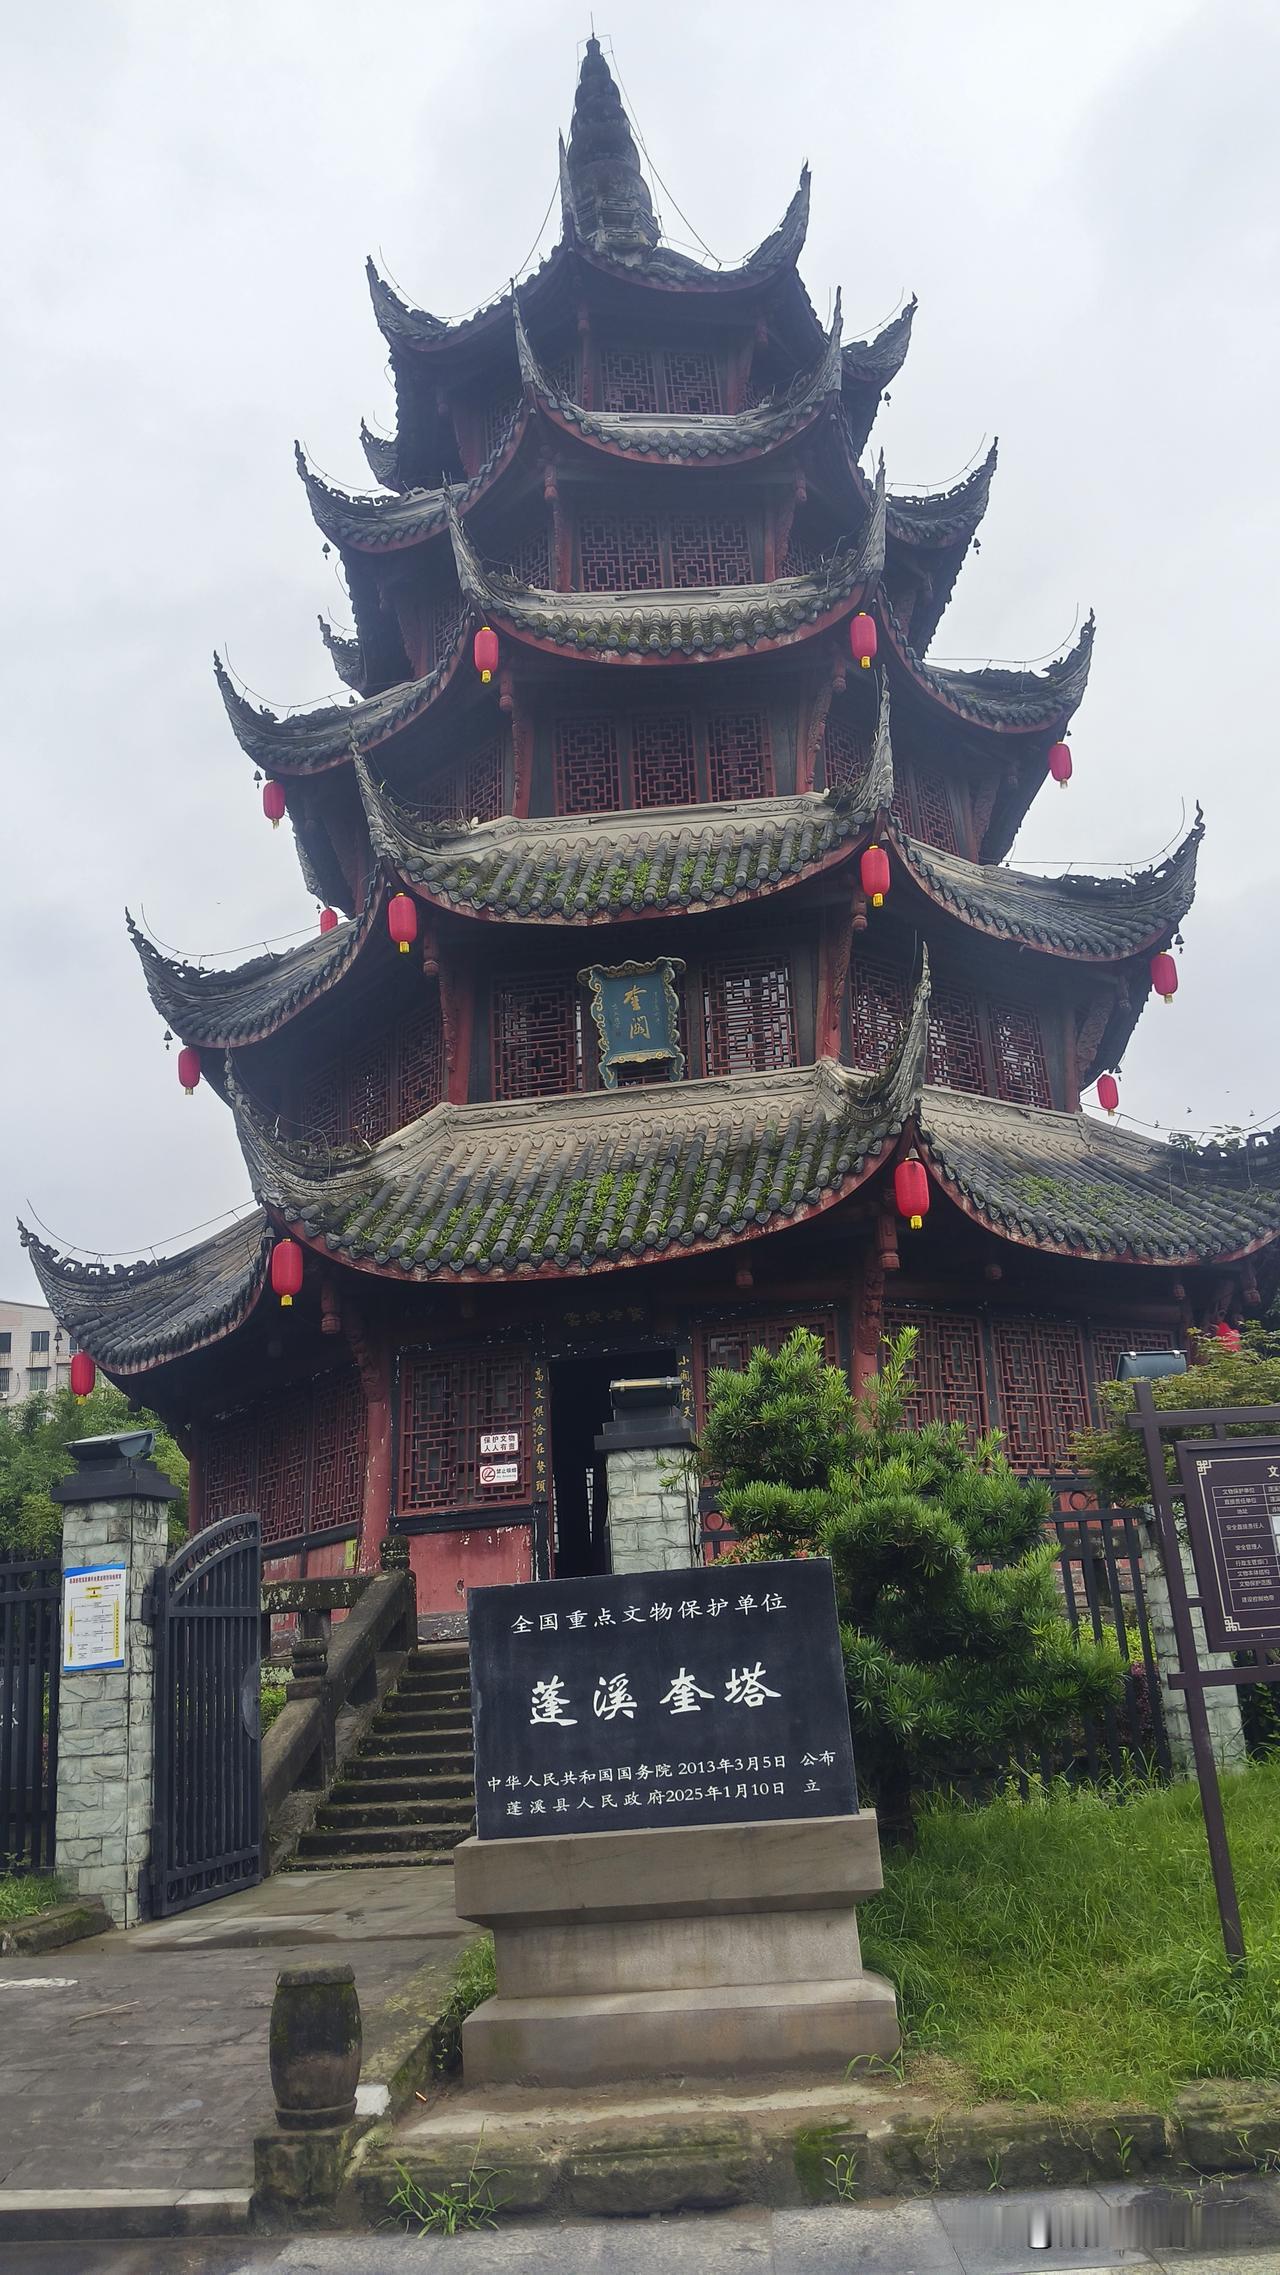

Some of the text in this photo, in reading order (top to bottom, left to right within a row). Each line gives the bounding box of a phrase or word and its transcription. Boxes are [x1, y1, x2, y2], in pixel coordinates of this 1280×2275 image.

[484, 1435, 515, 1443] 保护文物
[511, 1592, 787, 1634] 全国重点文物保护单位
[529, 1661, 782, 1726] 蓬溪奎塔
[803, 1779, 821, 1793] 立
